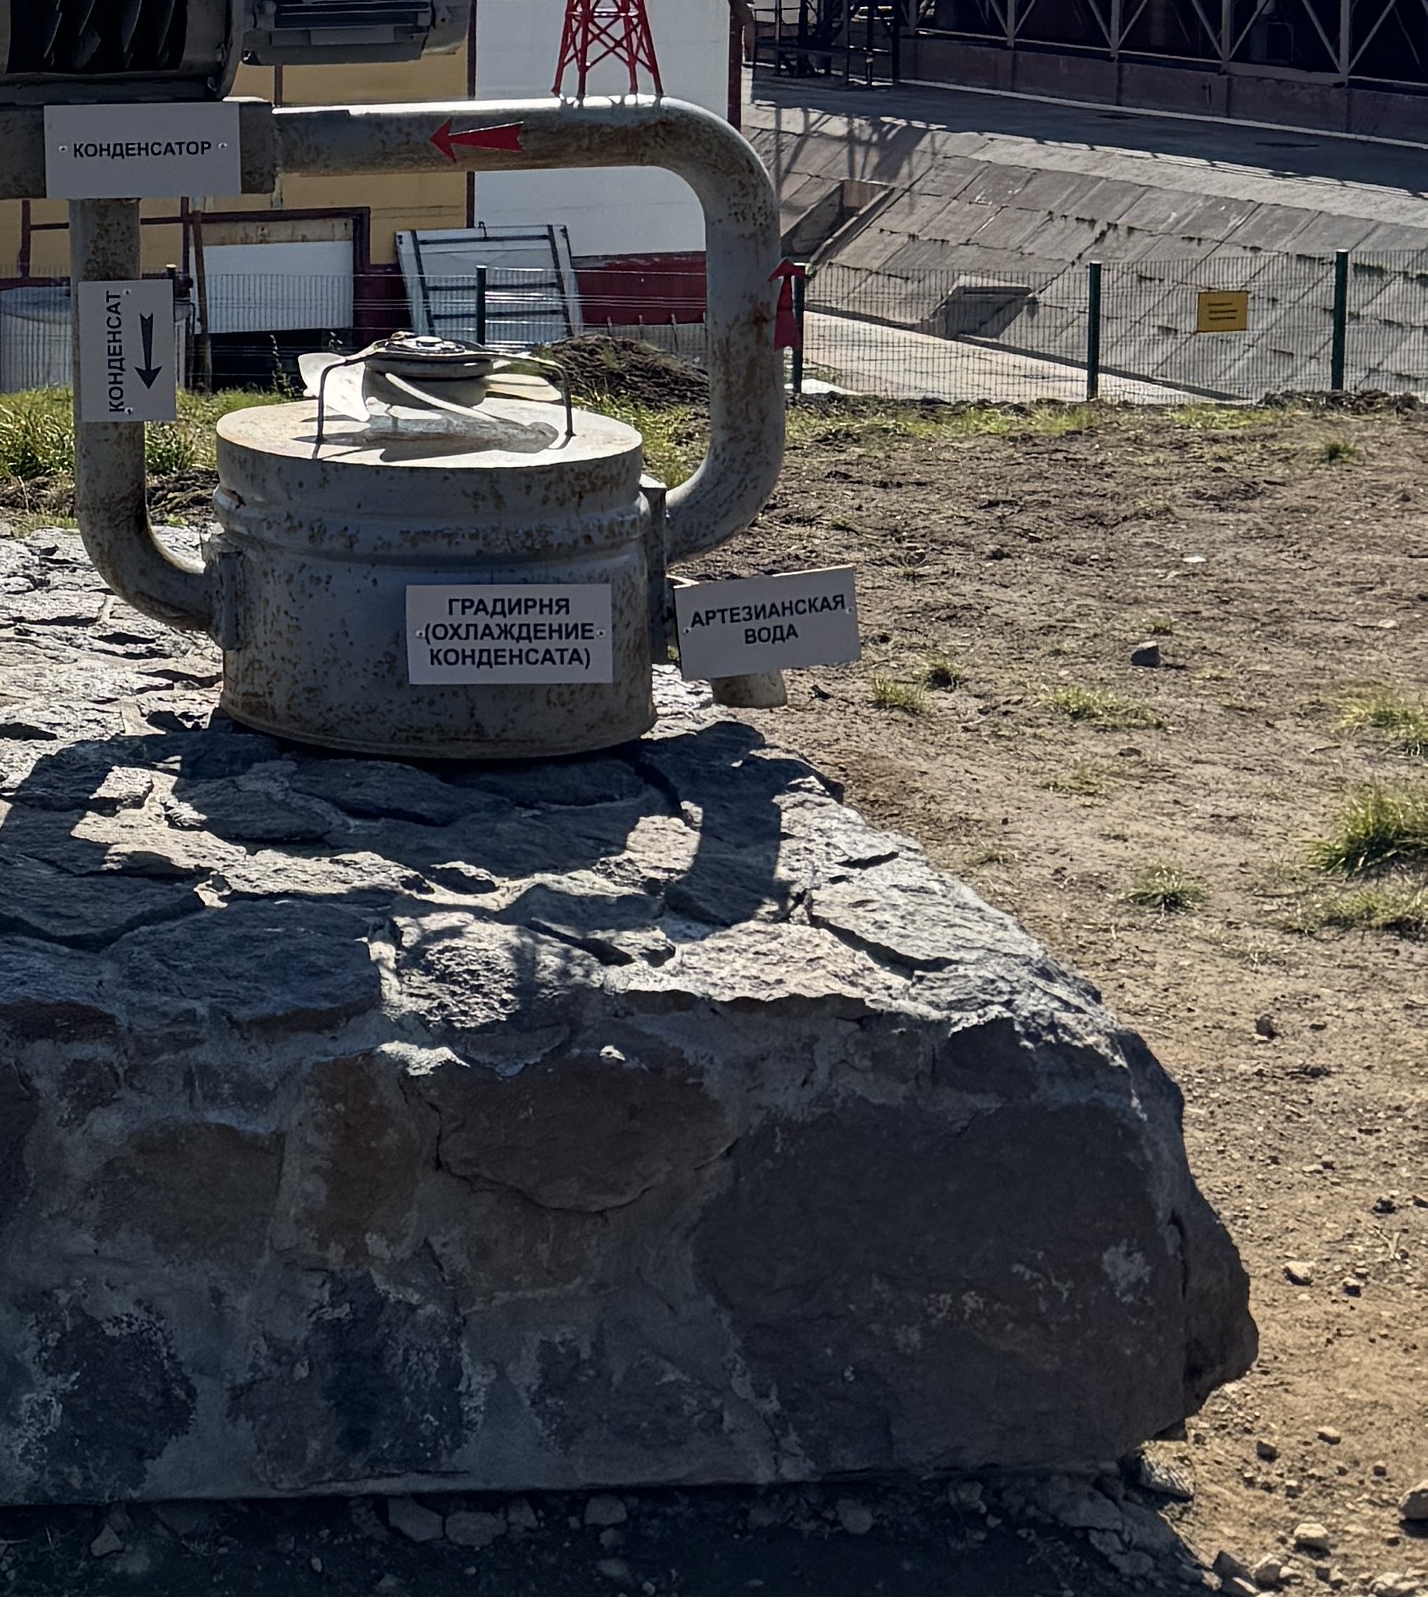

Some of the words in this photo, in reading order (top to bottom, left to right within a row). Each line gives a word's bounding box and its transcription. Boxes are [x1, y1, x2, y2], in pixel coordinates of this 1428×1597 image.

[72, 139, 213, 160] КОНДЕНСАТОР
[105, 290, 125, 413] КОНДЕНСАТ
[448, 597, 570, 617] ГРАДИРНЯ
[690, 593, 845, 628] АРТЕЗИАНСКАЯ
[424, 622, 595, 643] (ОХЛАЖДЕНИЕ
[743, 623, 799, 645] ВОДА
[429, 647, 590, 669] КОНДЕНСАТА)
